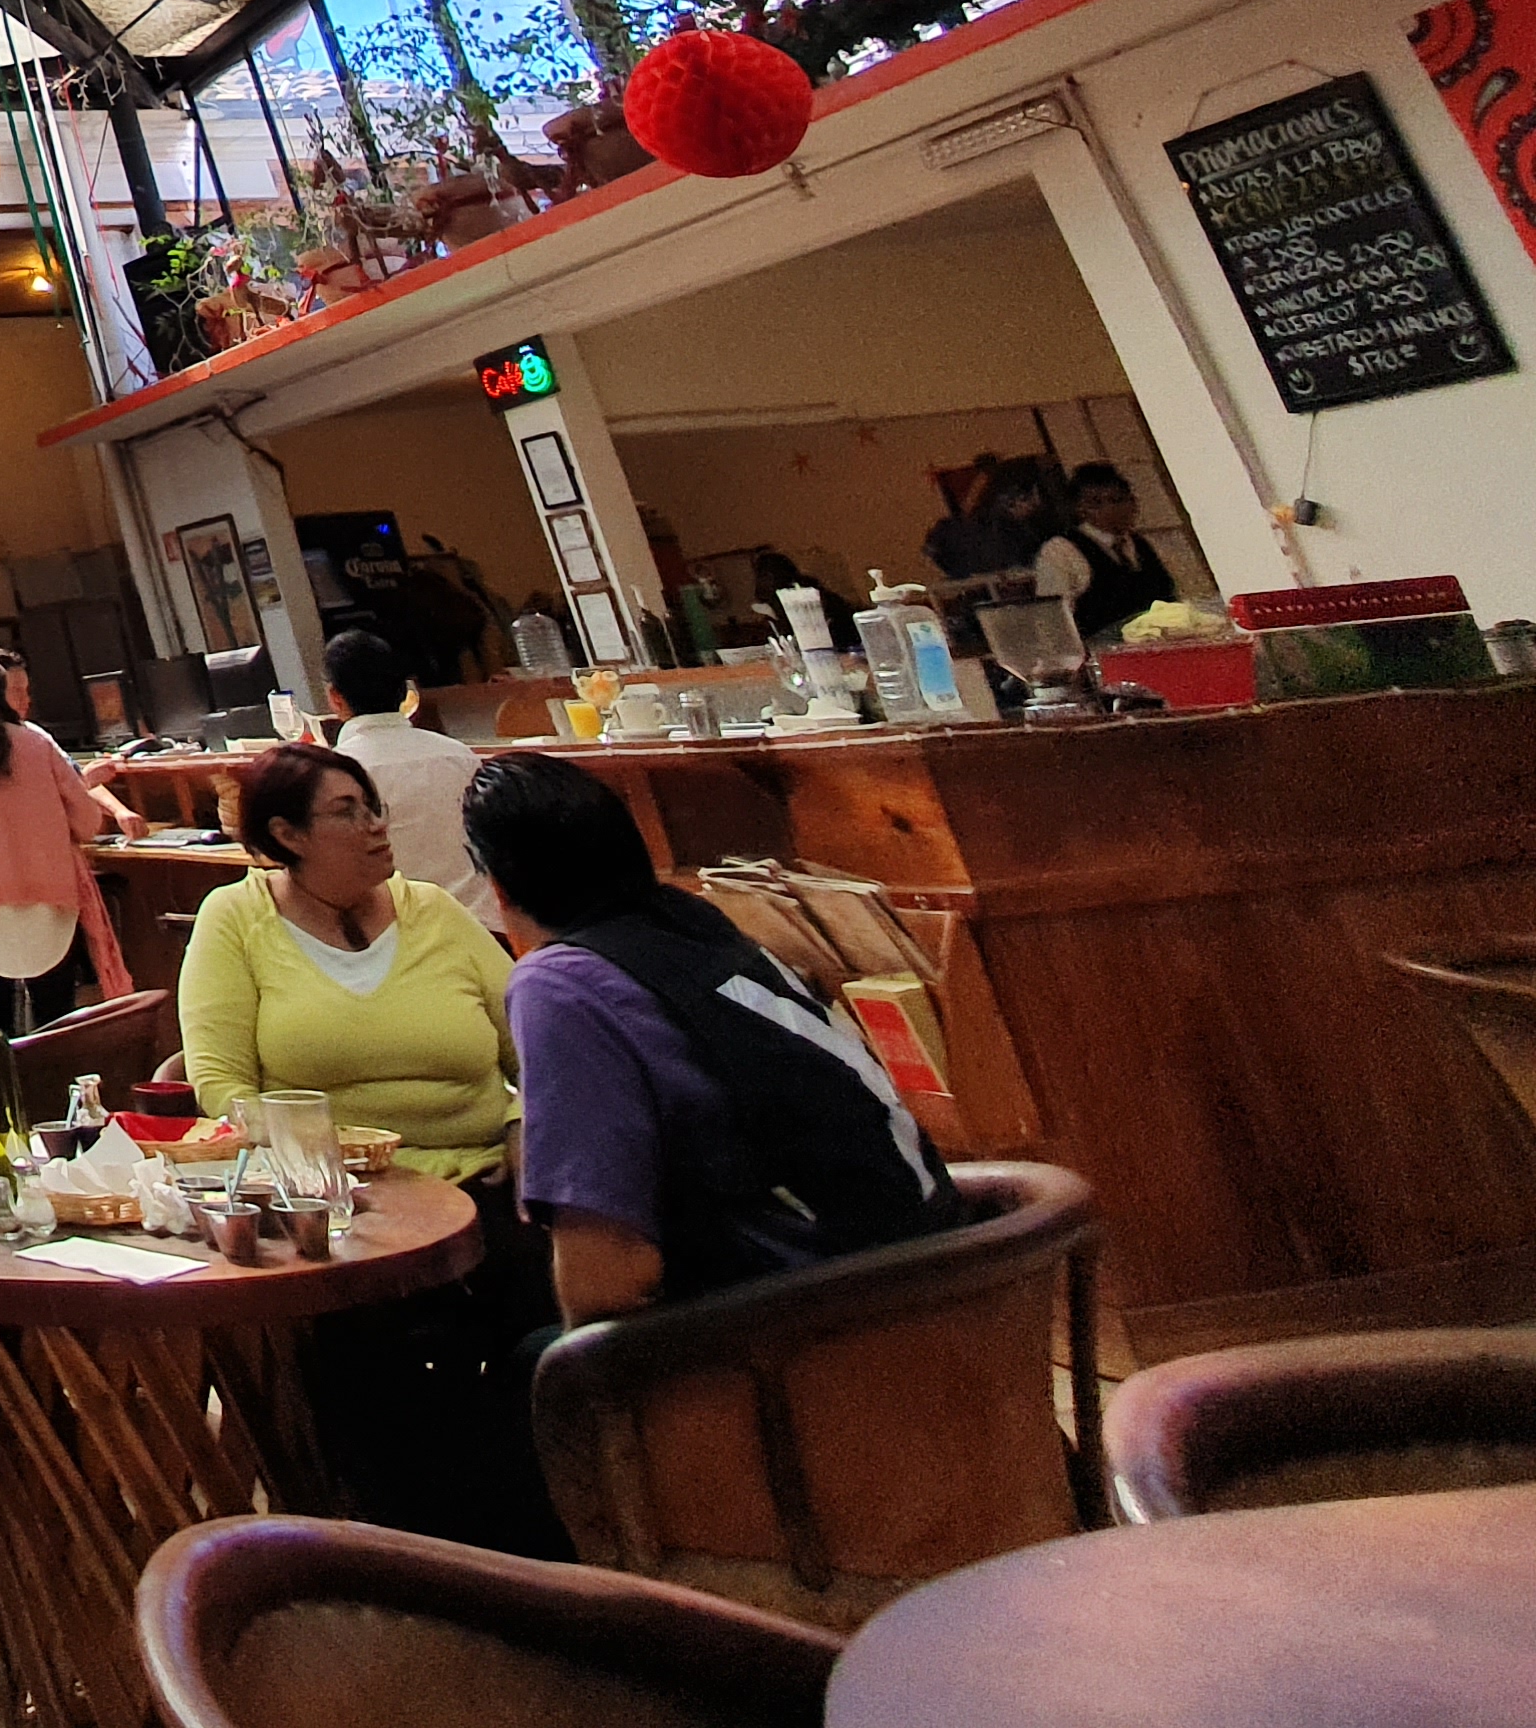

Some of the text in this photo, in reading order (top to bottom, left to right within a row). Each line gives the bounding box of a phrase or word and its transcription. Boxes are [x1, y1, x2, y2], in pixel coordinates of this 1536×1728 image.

[1179, 98, 1360, 181] PROMOCIONES
[1276, 160, 1294, 178] A
[1292, 148, 1327, 173] LA
[1253, 250, 1346, 293] CERVEZAS
